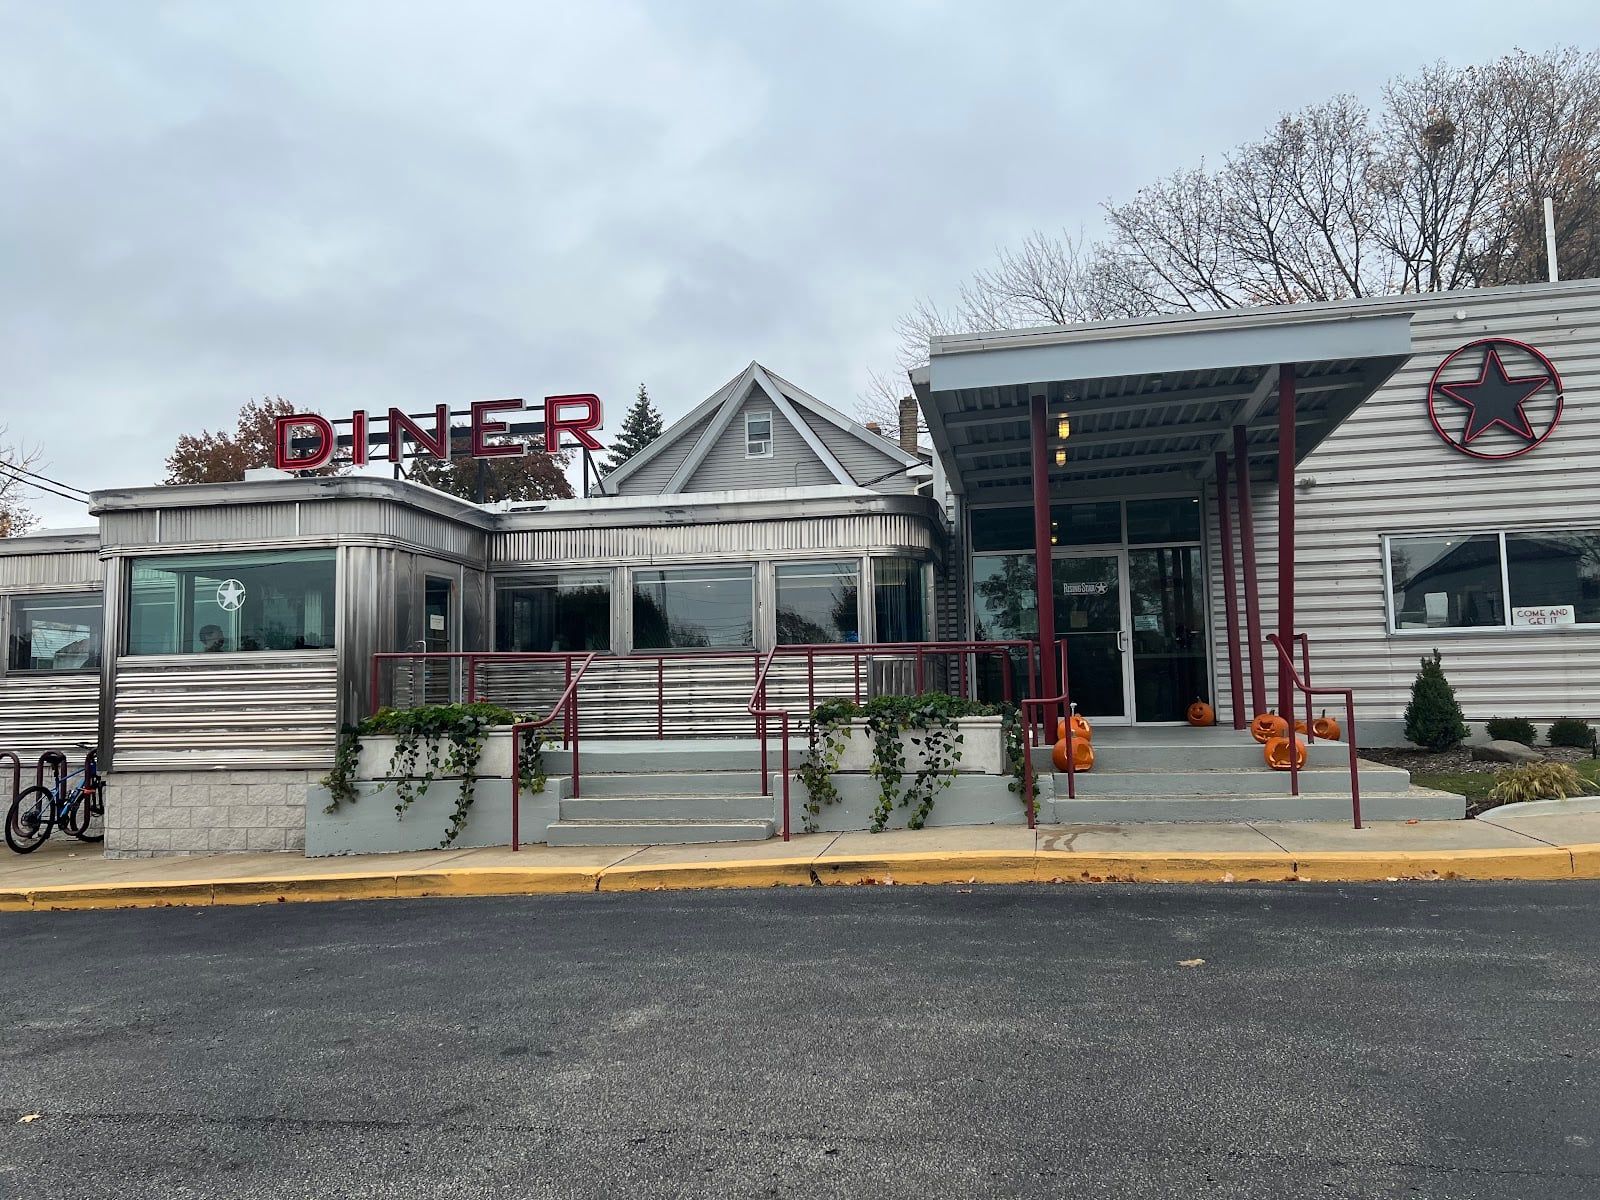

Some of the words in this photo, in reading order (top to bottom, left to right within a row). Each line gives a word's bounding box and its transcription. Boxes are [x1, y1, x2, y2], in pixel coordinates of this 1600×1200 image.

[275, 393, 604, 470] DINER
[1517, 609, 1546, 617] COME
[1549, 608, 1568, 616] AND
[1528, 617, 1546, 625] GET
